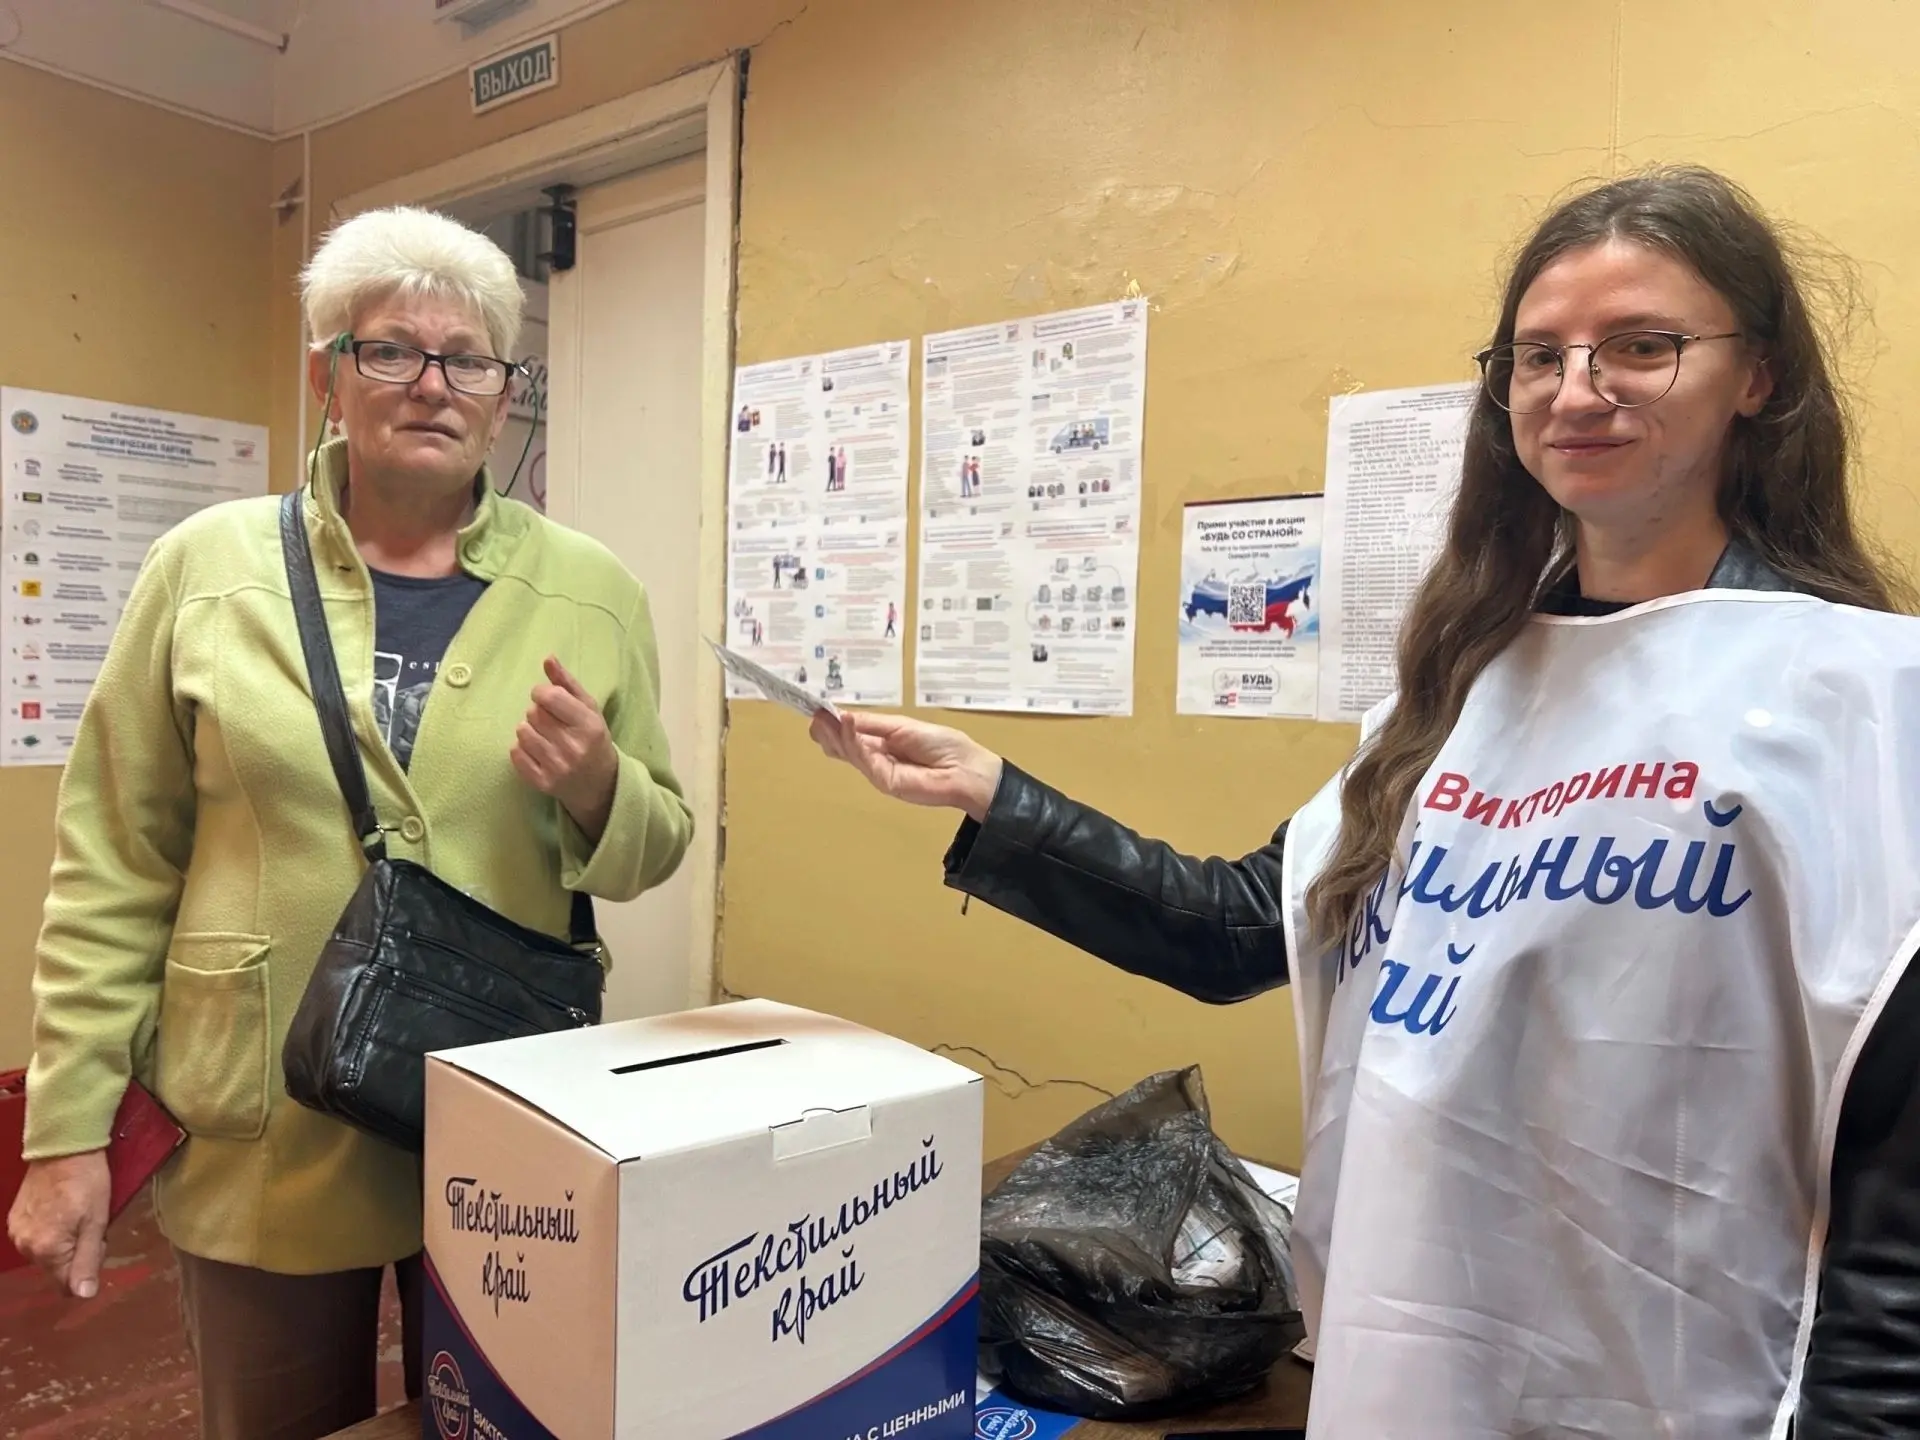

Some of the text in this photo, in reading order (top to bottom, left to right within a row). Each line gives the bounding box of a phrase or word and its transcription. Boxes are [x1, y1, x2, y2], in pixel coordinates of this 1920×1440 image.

[479, 50, 549, 101] ВЫХОД
[1197, 521, 1227, 530] Прими
[1229, 519, 1266, 529] участие
[1276, 517, 1305, 526] акции
[1200, 526, 1303, 541] «БУДЬ СО СТРАНОЙ!»
[1242, 674, 1273, 685] БУДЬ
[1424, 761, 1699, 829] Викторина
[446, 1176, 580, 1243] Текстильный
[683, 1134, 944, 1323] Текстильный
[482, 1251, 531, 1319] край
[771, 1244, 866, 1345] край
[867, 1426, 879, 1440] С
[882, 1390, 966, 1437] ЦЕННЫМИ
